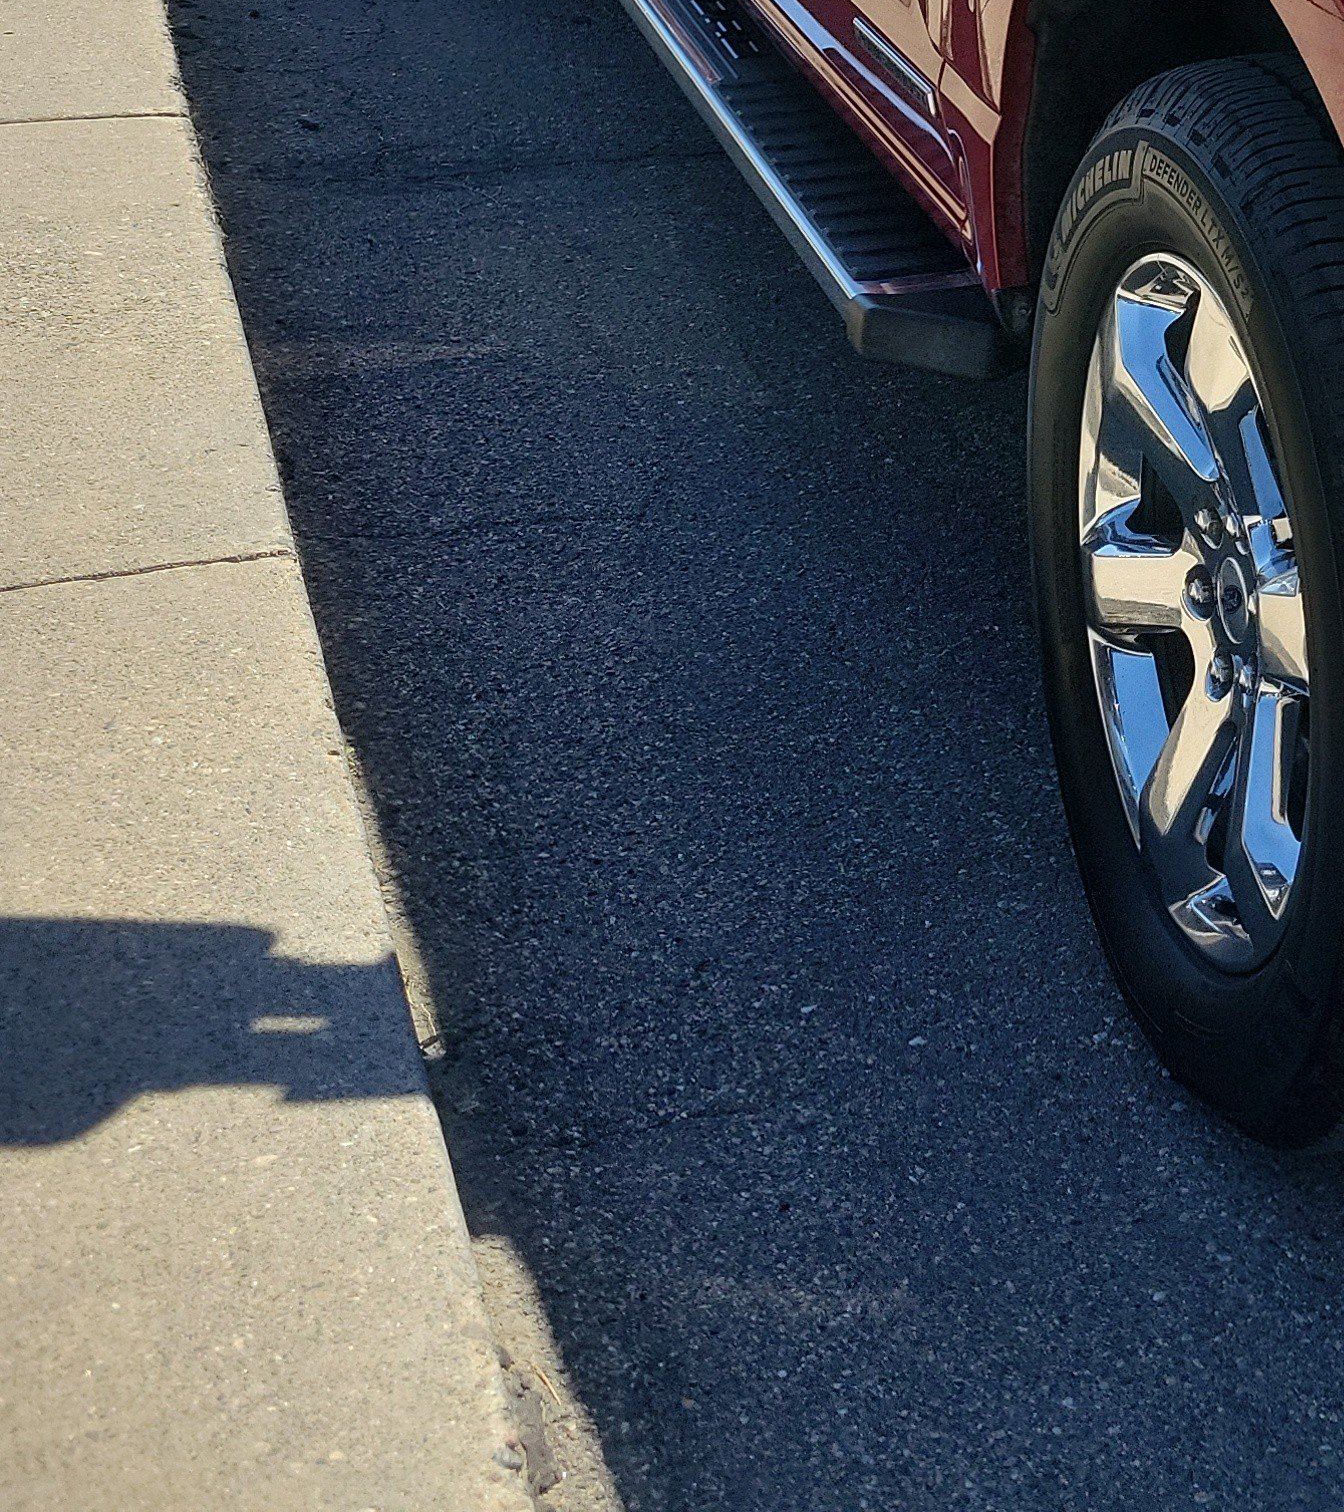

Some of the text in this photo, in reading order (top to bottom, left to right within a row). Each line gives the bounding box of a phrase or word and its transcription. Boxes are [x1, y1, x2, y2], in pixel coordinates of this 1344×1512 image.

[1061, 149, 1133, 244] MICHELIN
[1149, 154, 1201, 217] DEFENDER
[1199, 208, 1225, 250] LTX
